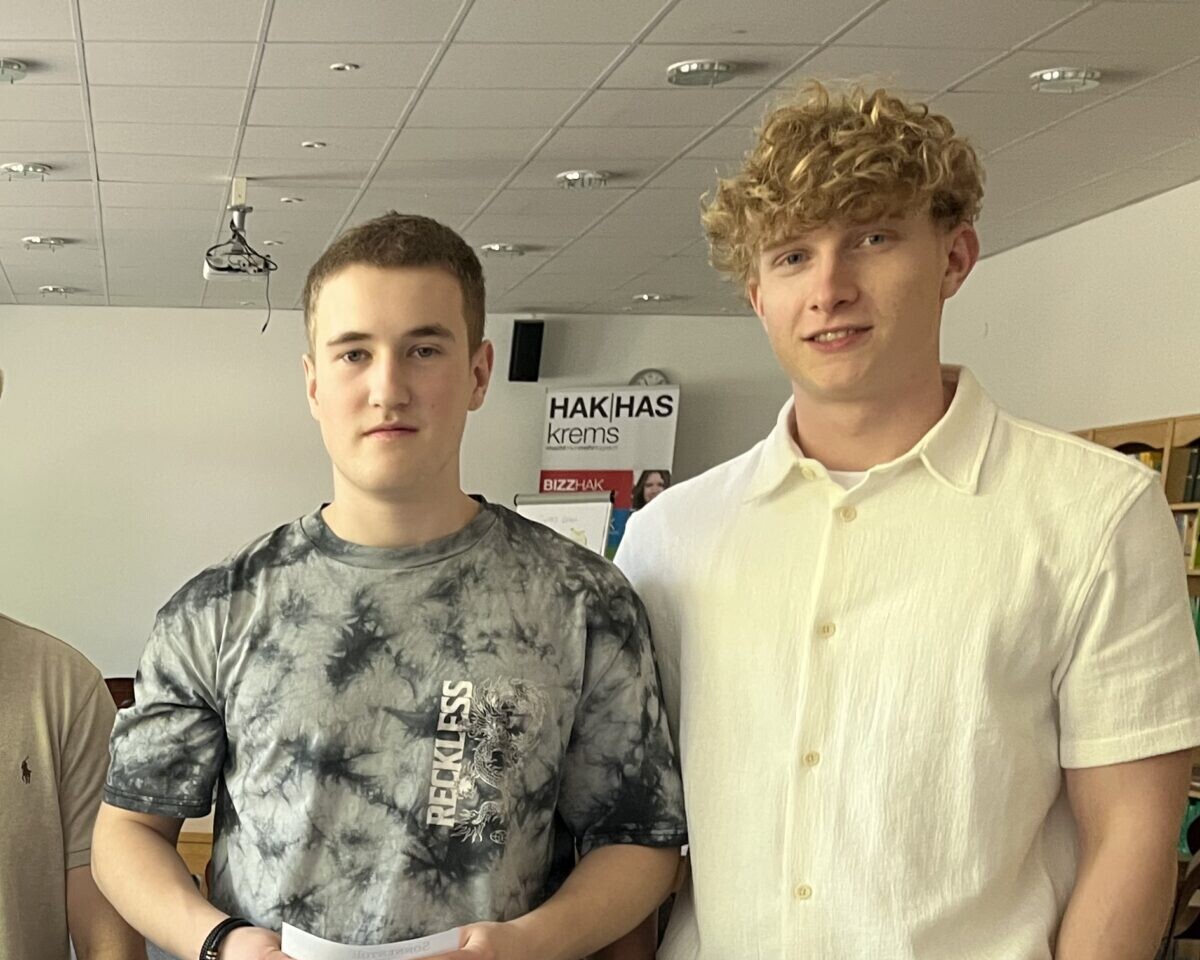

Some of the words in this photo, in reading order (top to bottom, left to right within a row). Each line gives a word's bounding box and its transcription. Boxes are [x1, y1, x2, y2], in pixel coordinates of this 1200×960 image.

[547, 423, 619, 444] krems
[543, 479, 604, 492] BIZZHAK
[427, 680, 473, 828] RECKLESS
